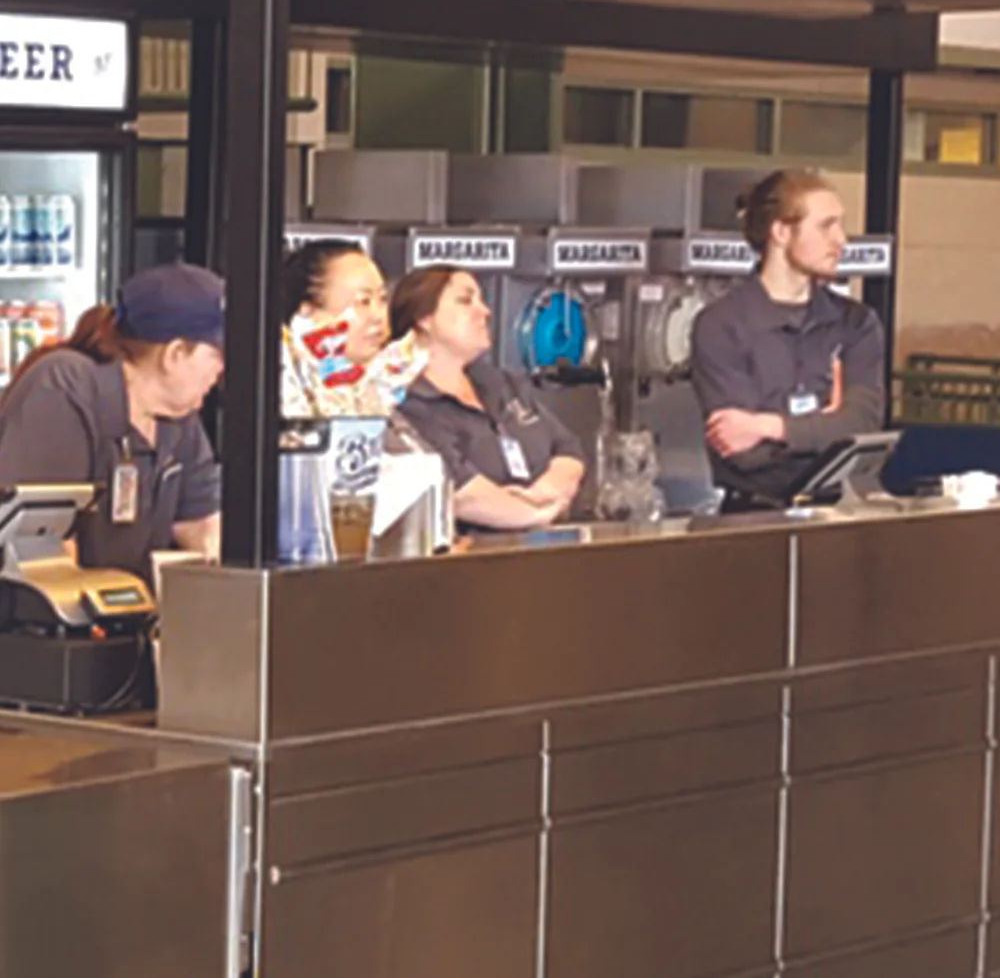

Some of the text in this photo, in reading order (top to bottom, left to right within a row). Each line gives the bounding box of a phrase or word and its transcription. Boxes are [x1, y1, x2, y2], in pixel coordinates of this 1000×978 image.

[0, 40, 74, 82] EER
[418, 240, 511, 262] MARGARITA
[557, 243, 643, 263] MARGARITA
[691, 243, 749, 263] MARGAR
